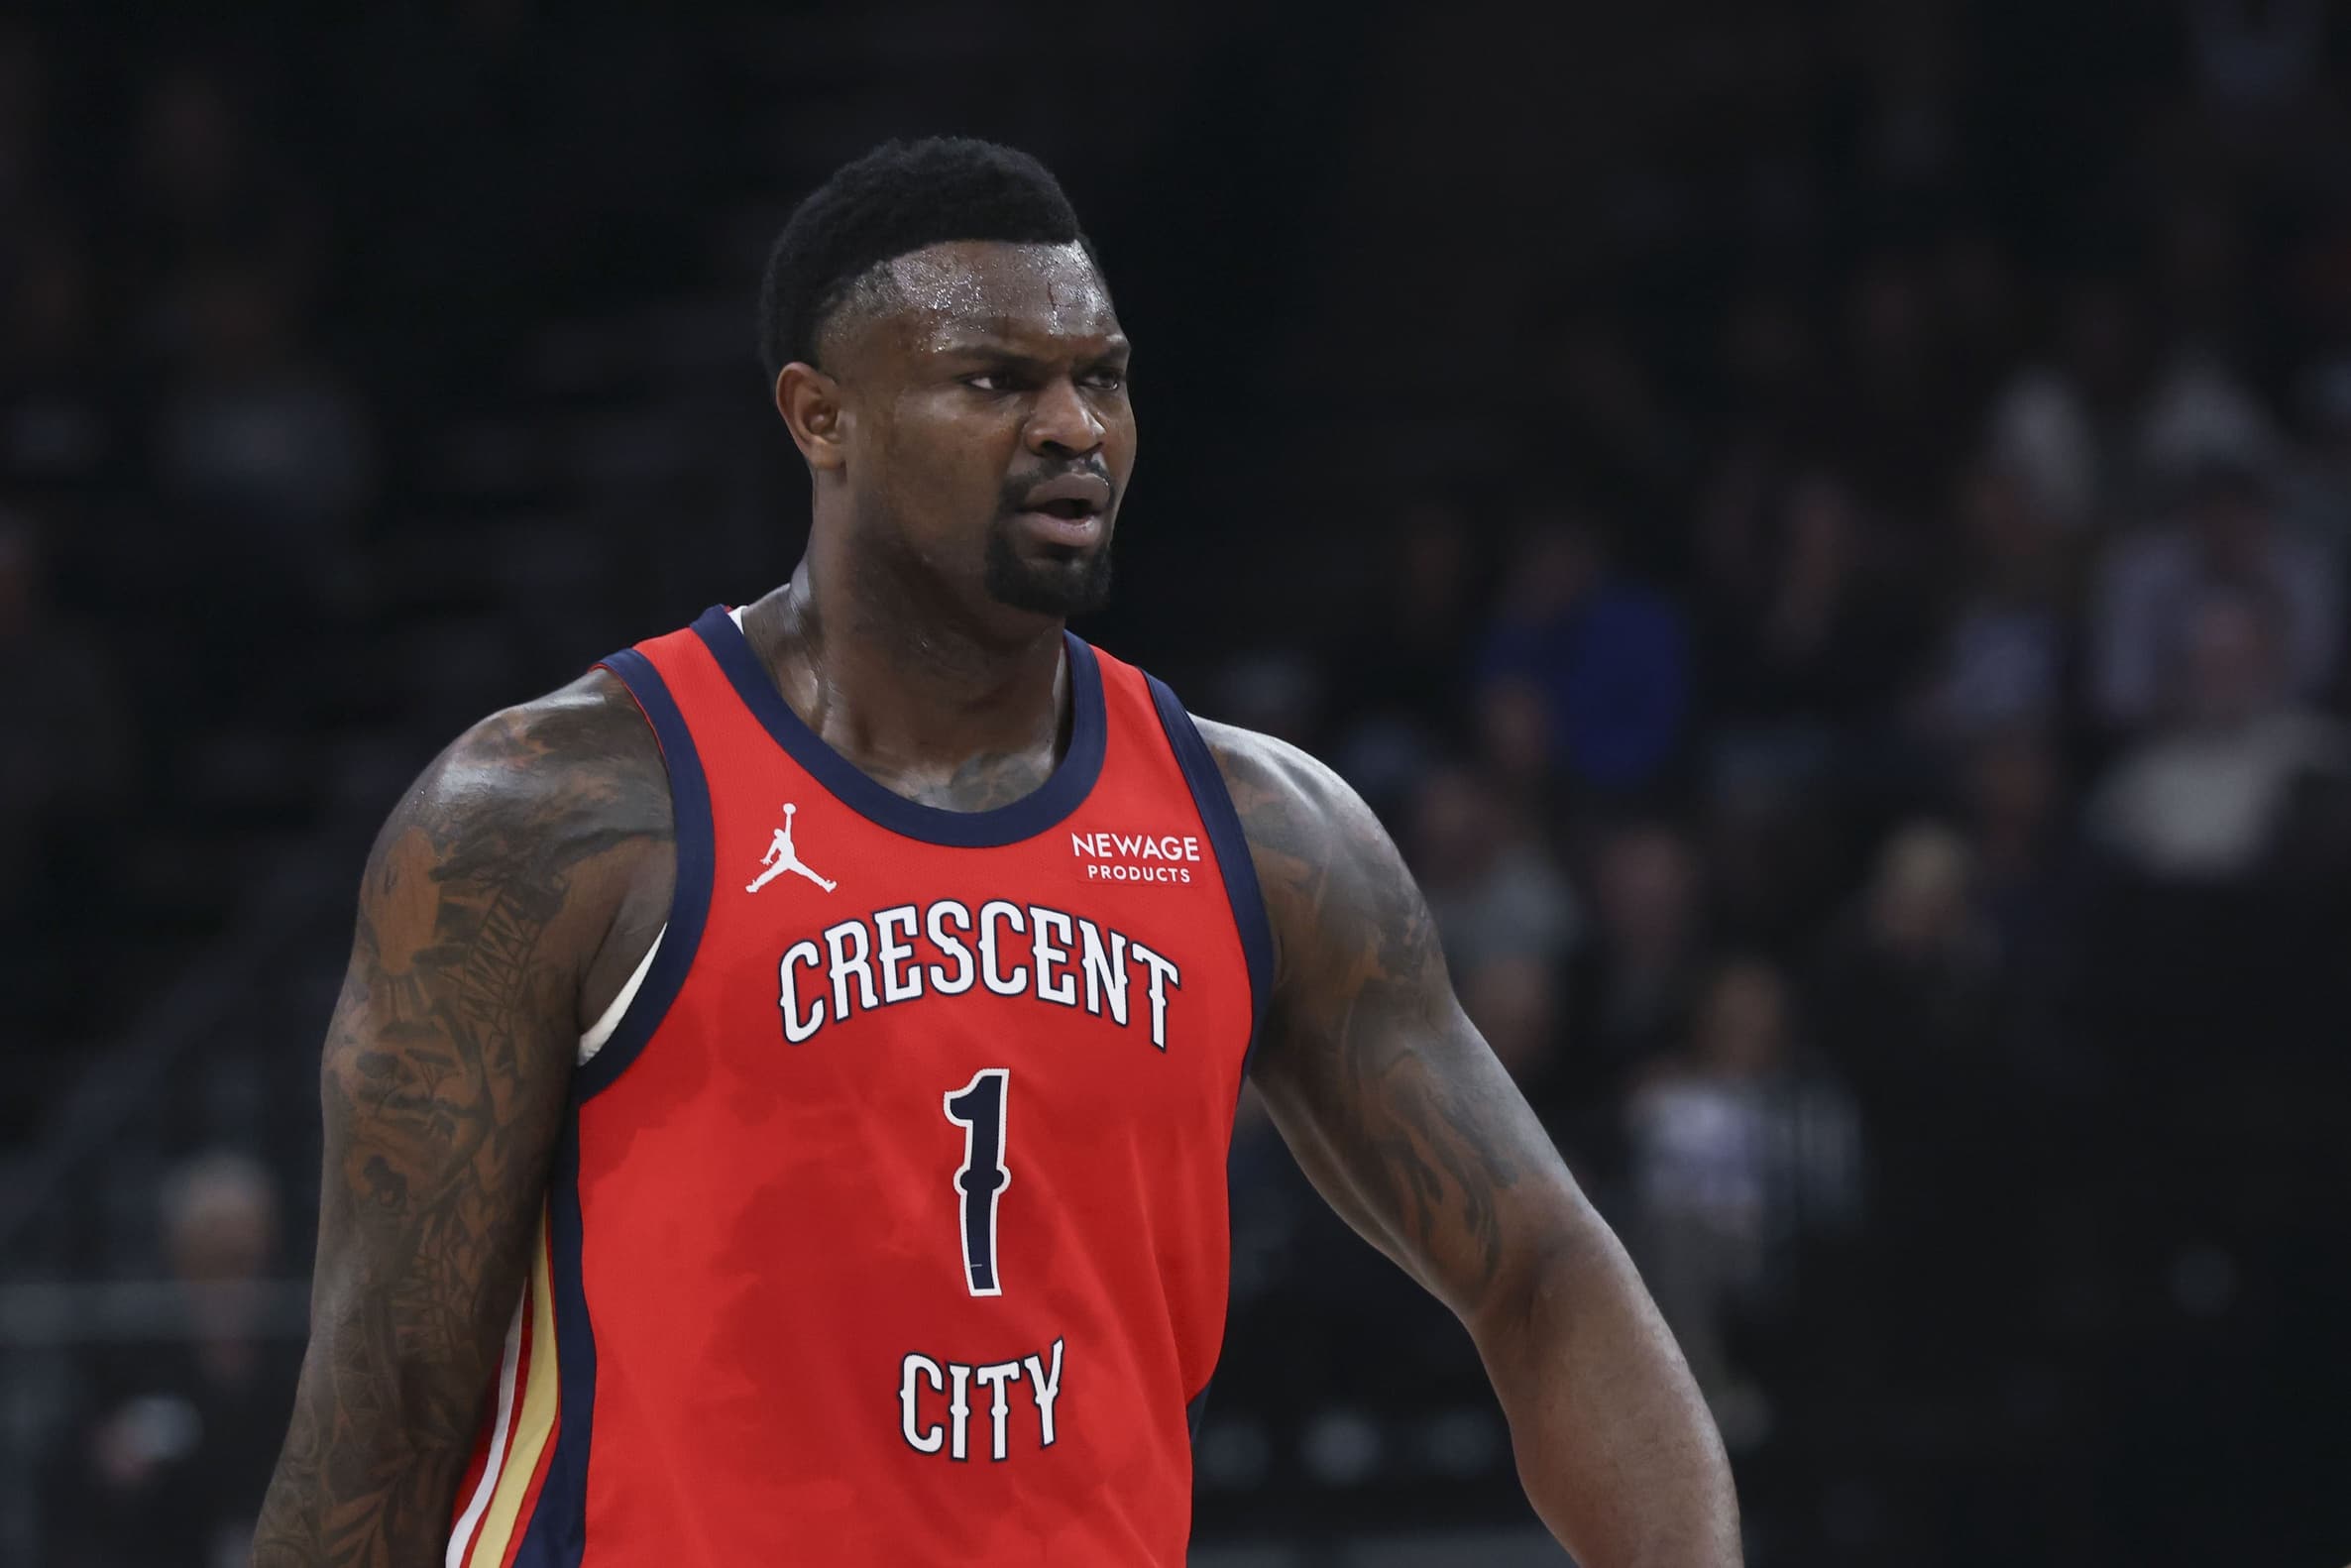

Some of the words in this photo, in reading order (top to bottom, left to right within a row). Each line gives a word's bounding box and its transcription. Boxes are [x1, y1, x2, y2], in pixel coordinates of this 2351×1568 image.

[1071, 833, 1200, 861] NEWAGE
[1087, 864, 1190, 883] PRODUCTS
[779, 899, 1181, 1051] CRESCENT
[944, 1067, 1011, 1297] 1
[899, 1336, 1064, 1461] CITY
